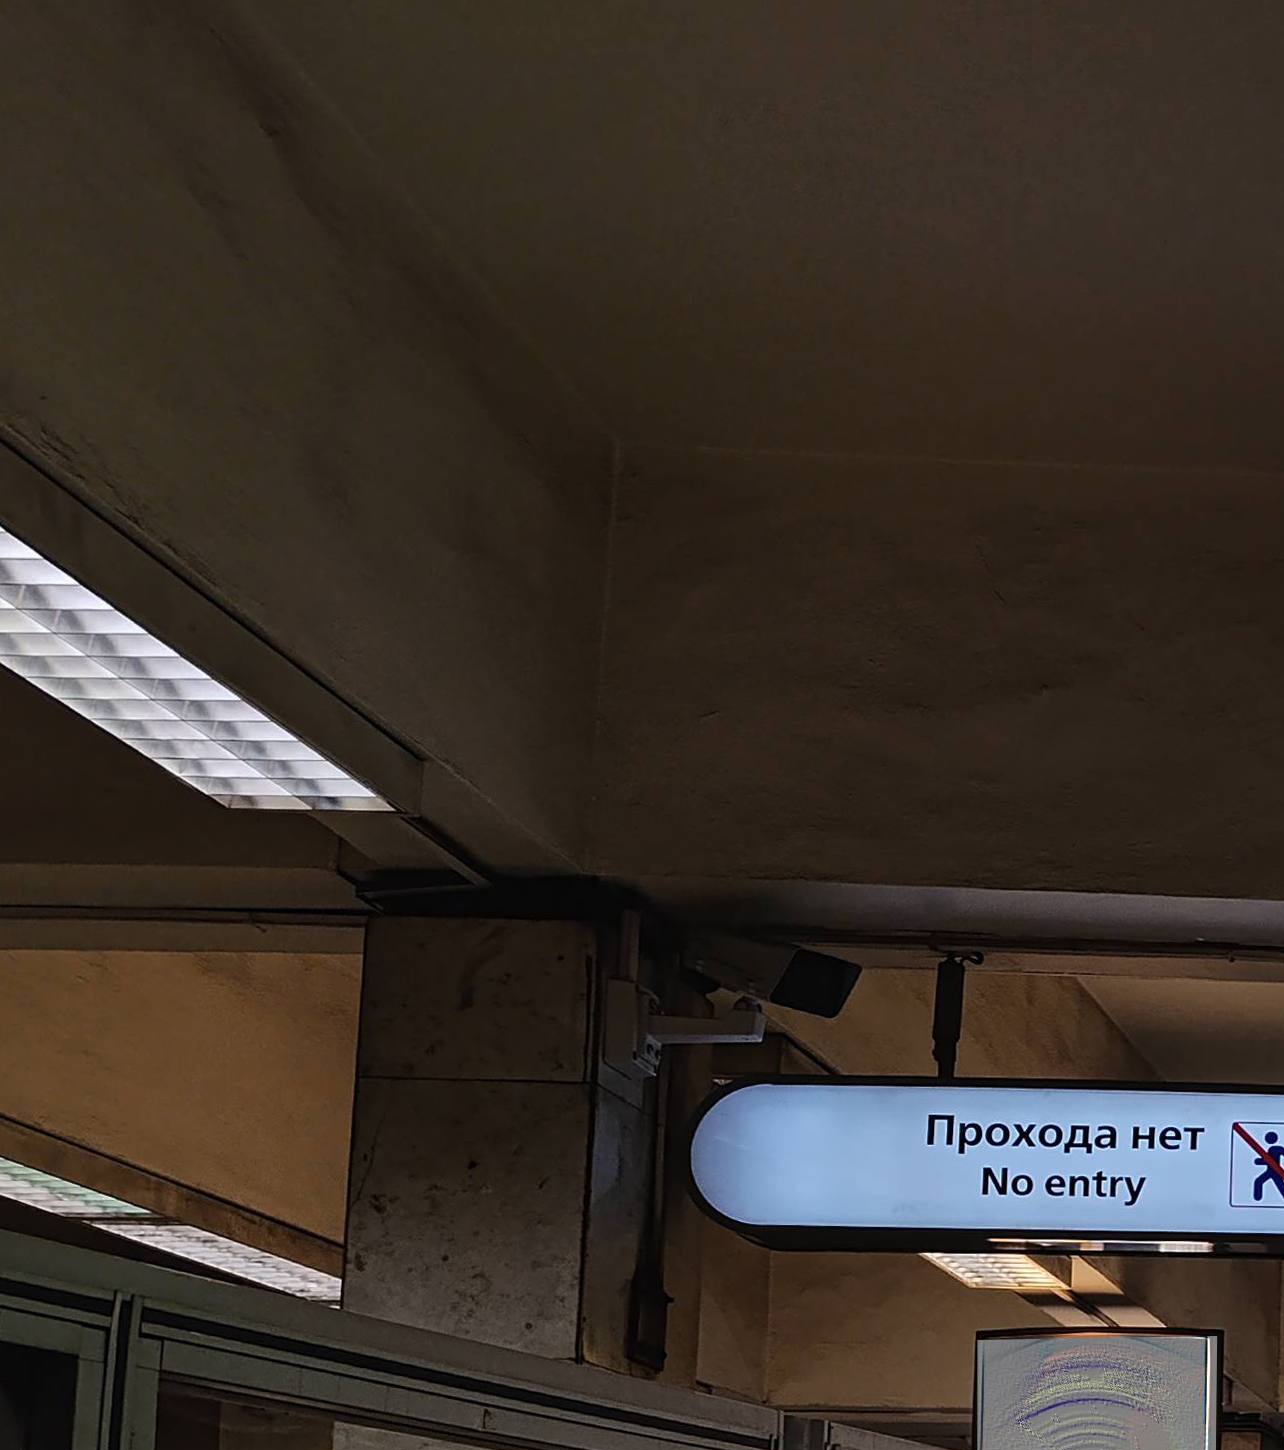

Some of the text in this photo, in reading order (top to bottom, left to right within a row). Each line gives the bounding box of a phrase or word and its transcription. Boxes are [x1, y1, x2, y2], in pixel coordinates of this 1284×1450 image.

[926, 1114, 1205, 1155] Прохода нет
[981, 1167, 1147, 1207] No entry
